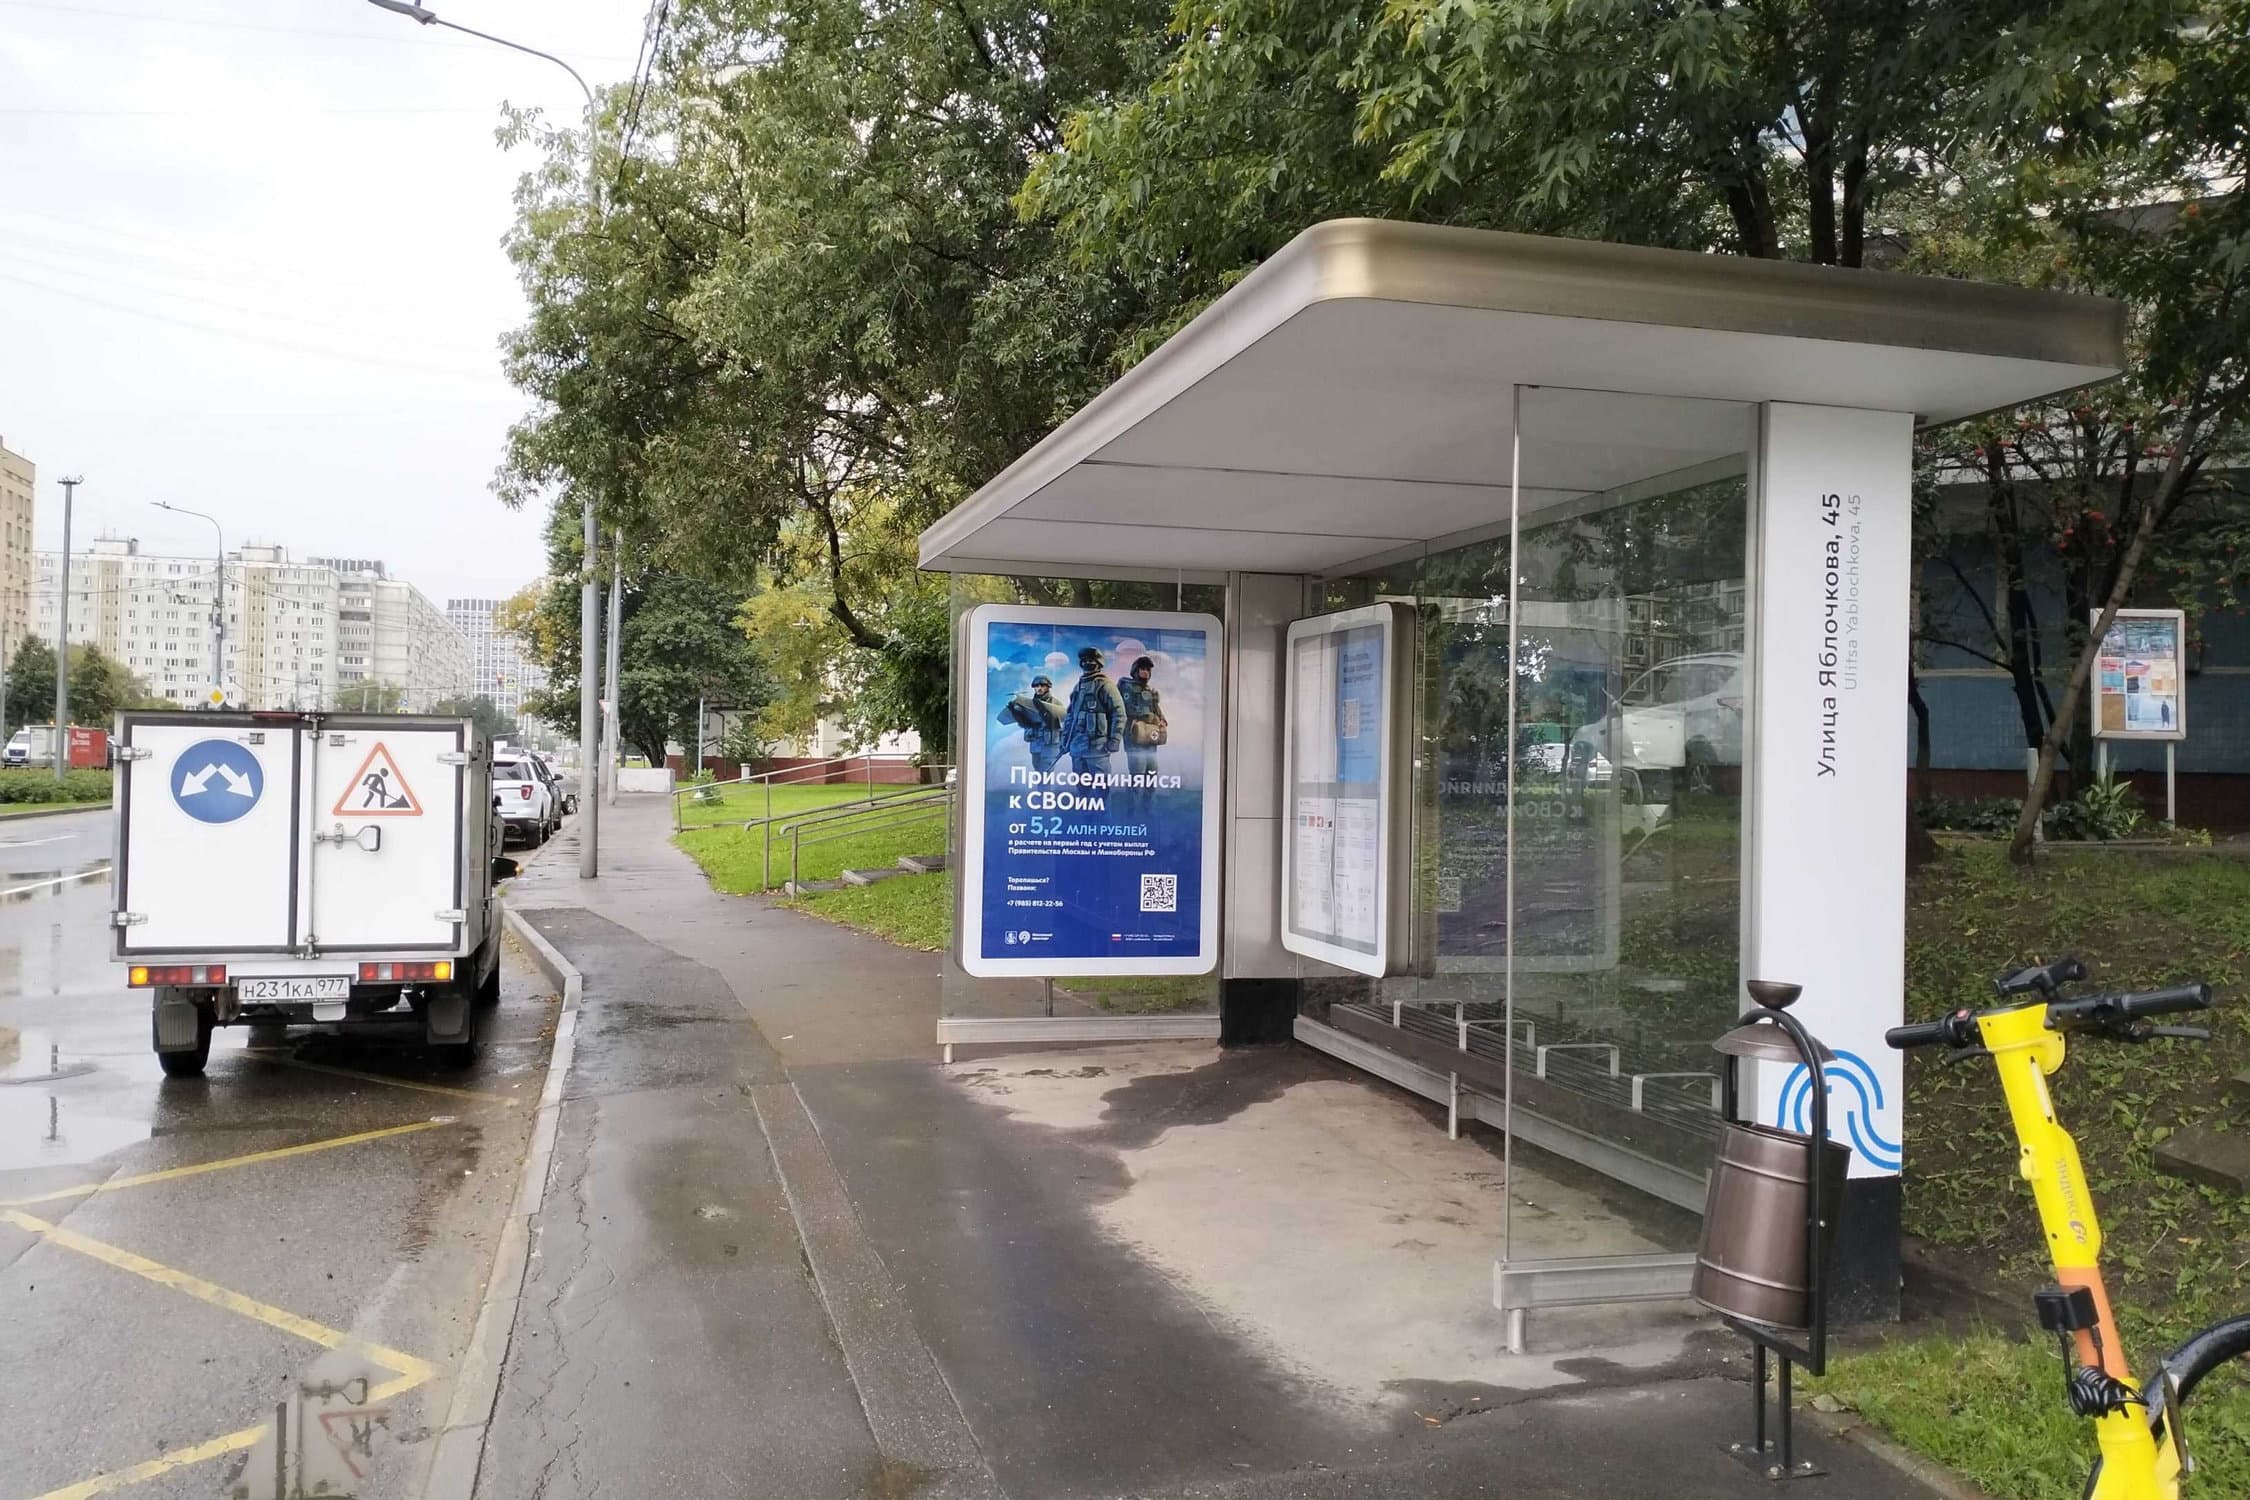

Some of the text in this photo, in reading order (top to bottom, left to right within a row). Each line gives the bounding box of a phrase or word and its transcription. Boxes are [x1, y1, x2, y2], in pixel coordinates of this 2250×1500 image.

[1844, 494, 1862, 690] Ulitsa Yablochkova, 45
[1817, 493, 1843, 777] Улица Яблочкова, 45
[1010, 766, 1182, 789] Присоединяйся
[1009, 791, 1105, 811] к СВОим
[1030, 816, 1063, 837] 5,2
[1067, 825, 1097, 836] МЛН
[1100, 824, 1148, 837] РУБЛЕЙ
[1008, 847, 1061, 856] Правительства
